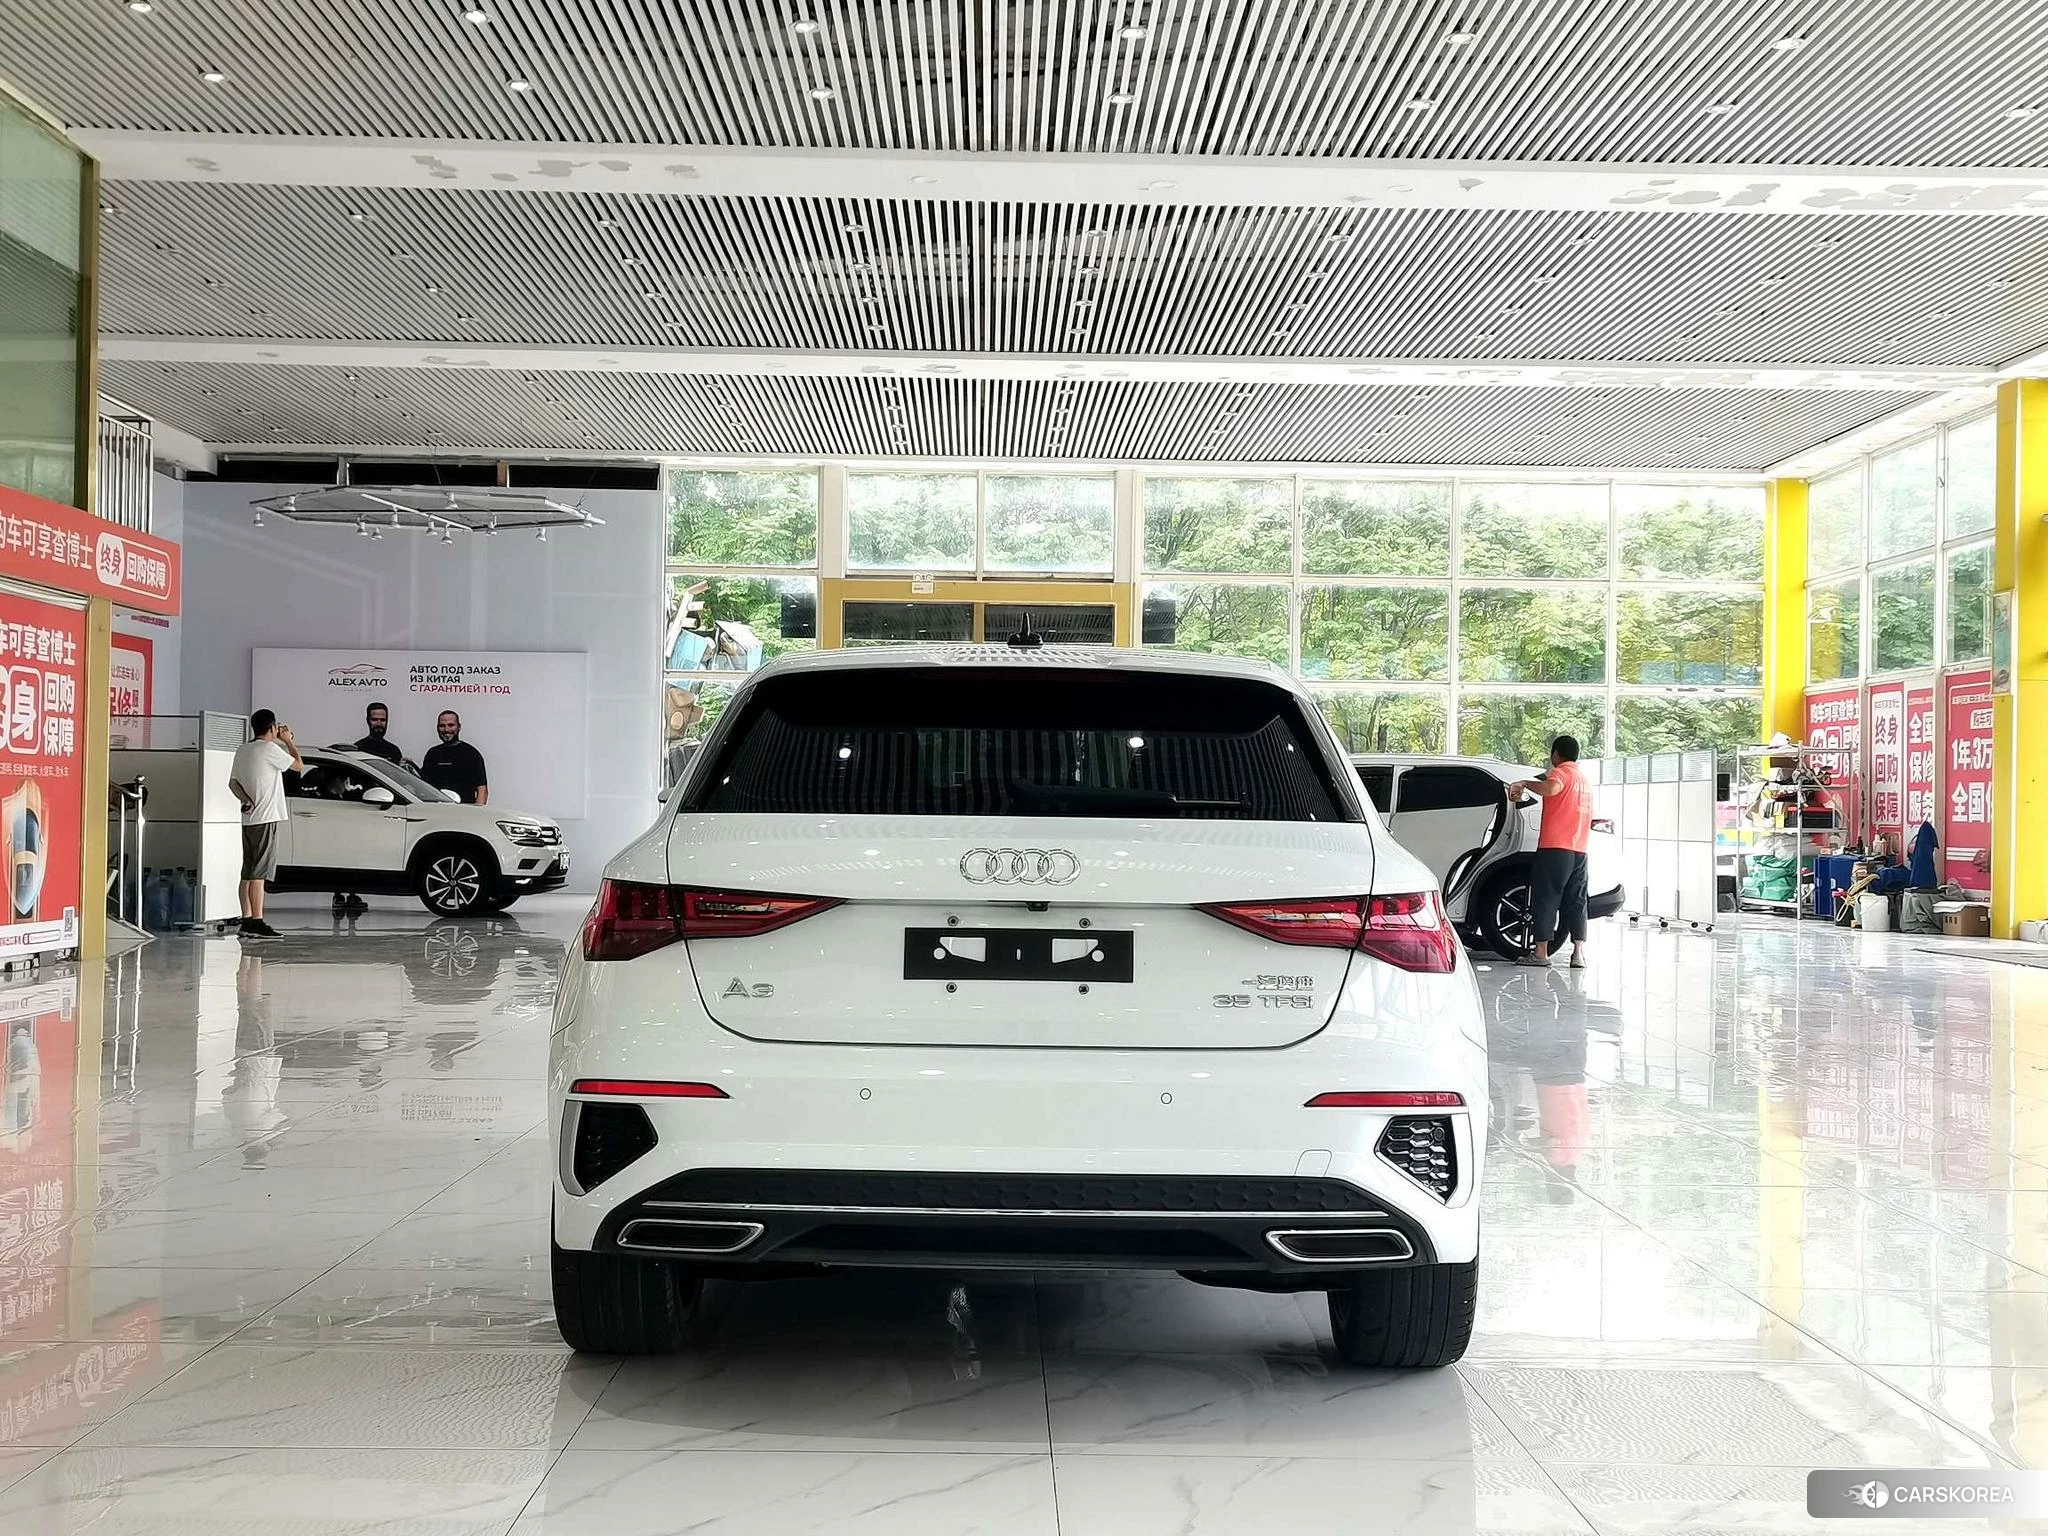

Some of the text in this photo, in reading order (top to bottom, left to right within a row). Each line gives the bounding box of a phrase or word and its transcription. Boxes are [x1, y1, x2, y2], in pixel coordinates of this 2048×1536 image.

[100, 543, 122, 577] 终身
[409, 665, 501, 675] АВТО ПОД ЗАКАЗ
[328, 678, 388, 687] ALEX AVTO
[410, 675, 461, 684] ИЗ КИТАЯ
[44, 671, 76, 715] 回购
[409, 684, 417, 692] С
[419, 684, 480, 694] ГАРАНТИЕЙ
[489, 685, 511, 695] ГОД
[43, 716, 75, 758] 保障
[1875, 714, 1898, 745] 终身
[722, 977, 775, 999] A3
[1212, 994, 1315, 1009] 35 TFSI
